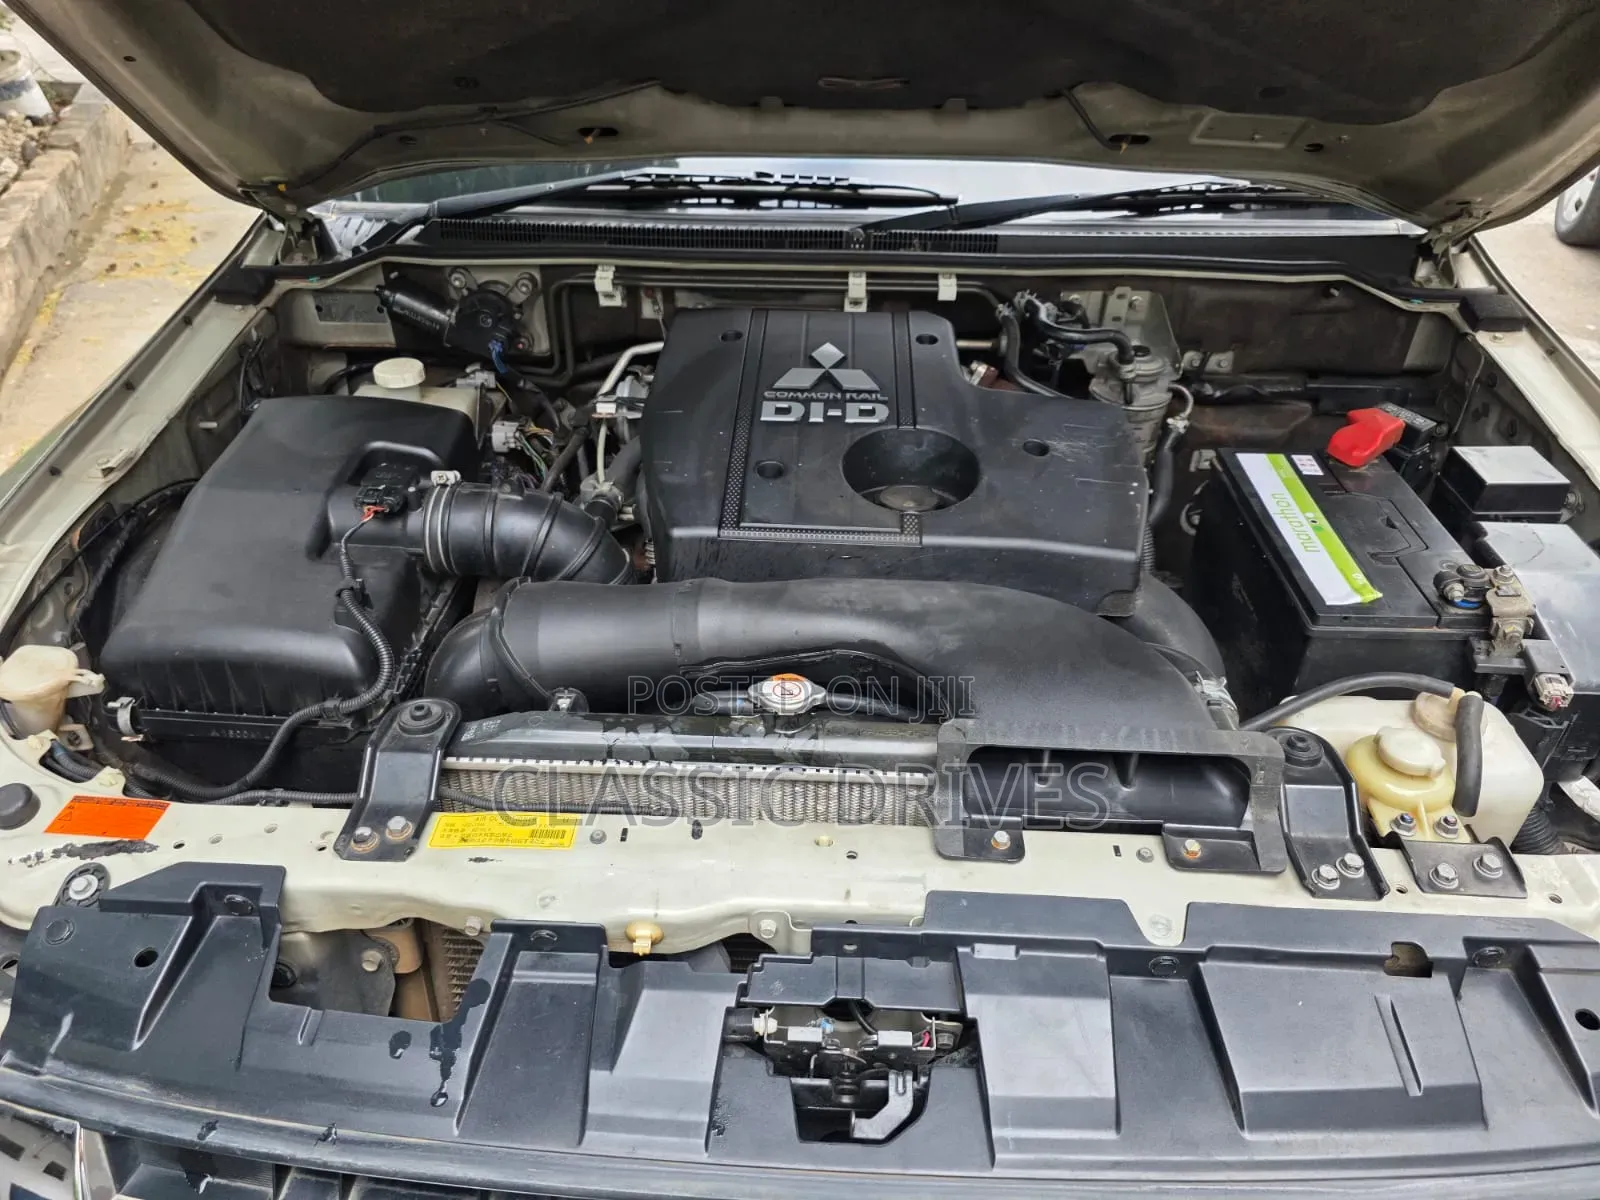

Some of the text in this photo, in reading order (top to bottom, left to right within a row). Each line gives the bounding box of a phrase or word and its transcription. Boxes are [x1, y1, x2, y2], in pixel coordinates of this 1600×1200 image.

[763, 391, 889, 401] COMMON RAIL
[760, 400, 890, 424] DI-D
[1271, 492, 1321, 553] marathon
